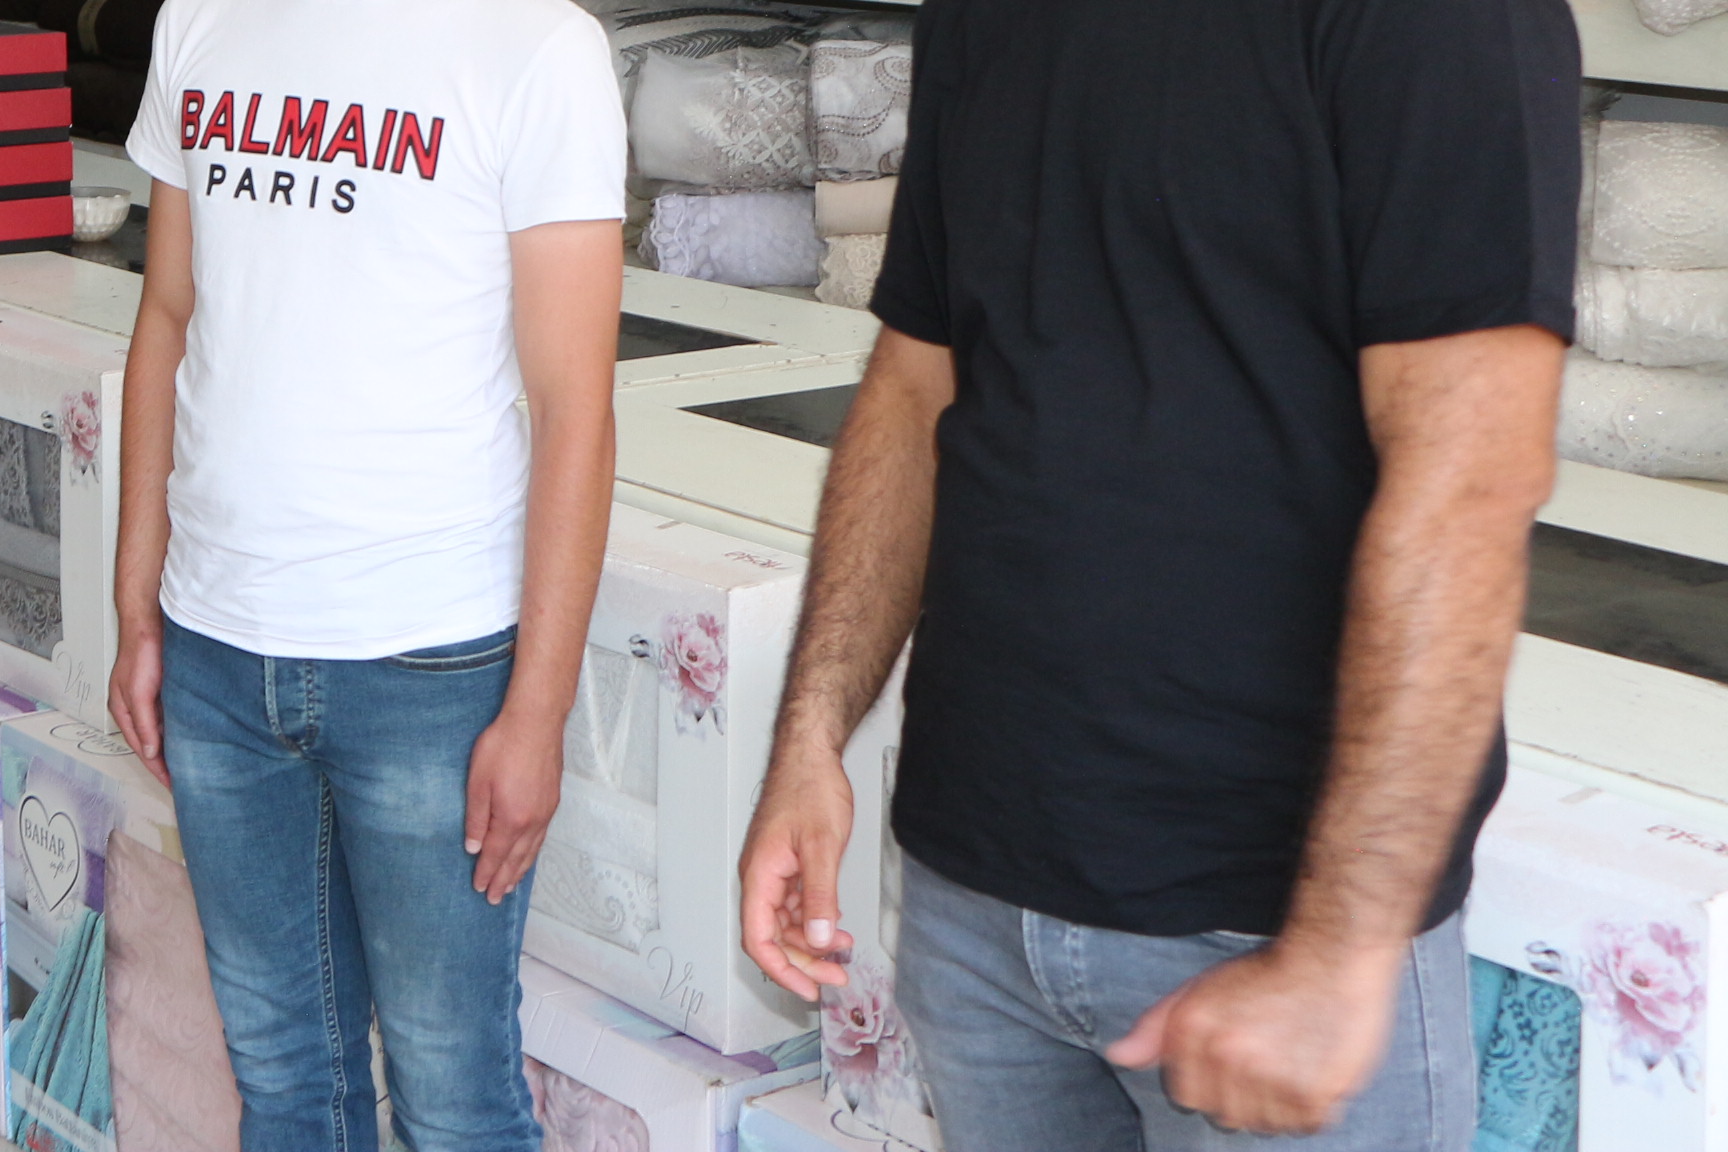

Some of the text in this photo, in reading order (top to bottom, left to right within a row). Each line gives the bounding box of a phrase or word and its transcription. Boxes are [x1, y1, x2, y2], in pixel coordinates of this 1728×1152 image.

[180, 89, 445, 181] BALMAIN
[206, 163, 357, 214] PARIS
[23, 818, 67, 861] BAHAR
[647, 945, 704, 1033] Vip
